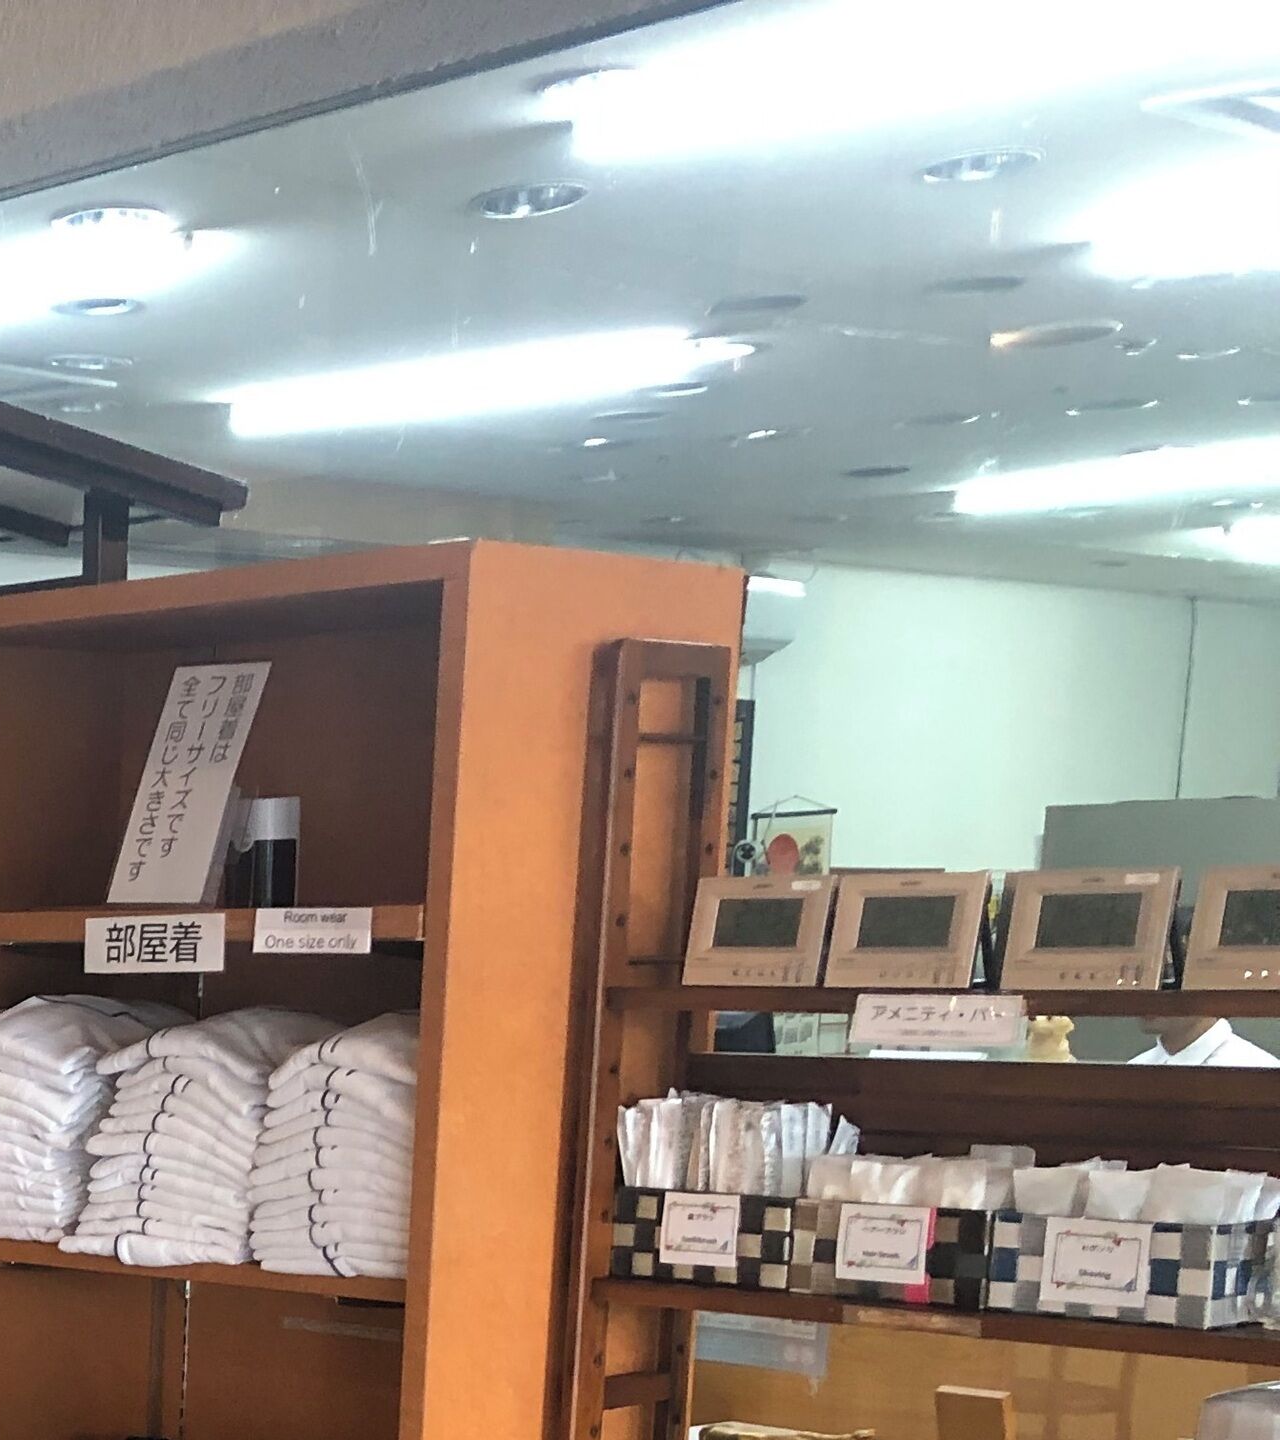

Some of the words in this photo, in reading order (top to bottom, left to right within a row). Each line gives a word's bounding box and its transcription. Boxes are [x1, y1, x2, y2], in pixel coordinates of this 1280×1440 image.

[208, 673, 255, 763] 部屋着は
[127, 676, 202, 882] 全て同じ大きさです
[159, 675, 227, 858] フリーサイズです
[104, 921, 203, 965] 部屋着
[264, 934, 294, 949] One
[298, 934, 326, 949] size
[328, 933, 358, 950] only
[283, 911, 318, 924] Room
[320, 912, 348, 924] wear
